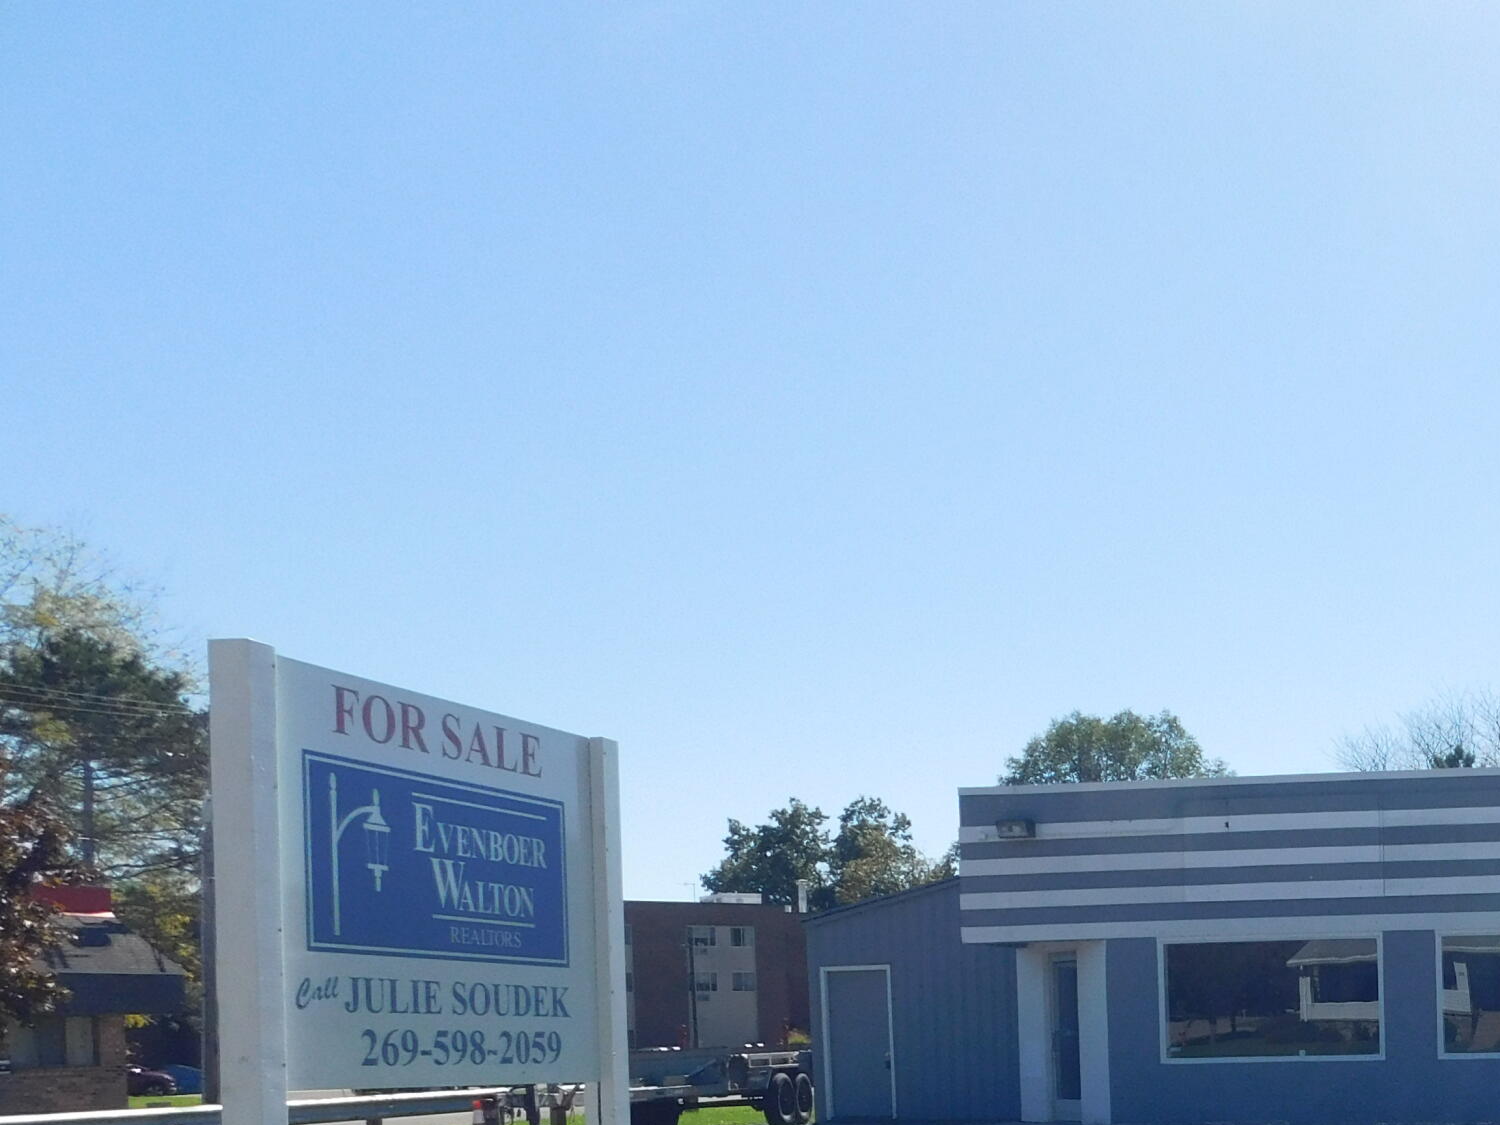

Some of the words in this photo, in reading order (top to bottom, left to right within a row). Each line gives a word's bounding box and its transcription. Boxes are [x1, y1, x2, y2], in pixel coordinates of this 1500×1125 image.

[332, 683, 429, 754] FOR
[442, 712, 543, 778] SALE
[430, 857, 535, 919] WALTON
[449, 926, 522, 948] REALTORS
[295, 976, 339, 1010] Call
[345, 976, 442, 1015] JULIE
[452, 981, 571, 1019] SOUDEK
[361, 1028, 562, 1067] 269-598-2059
